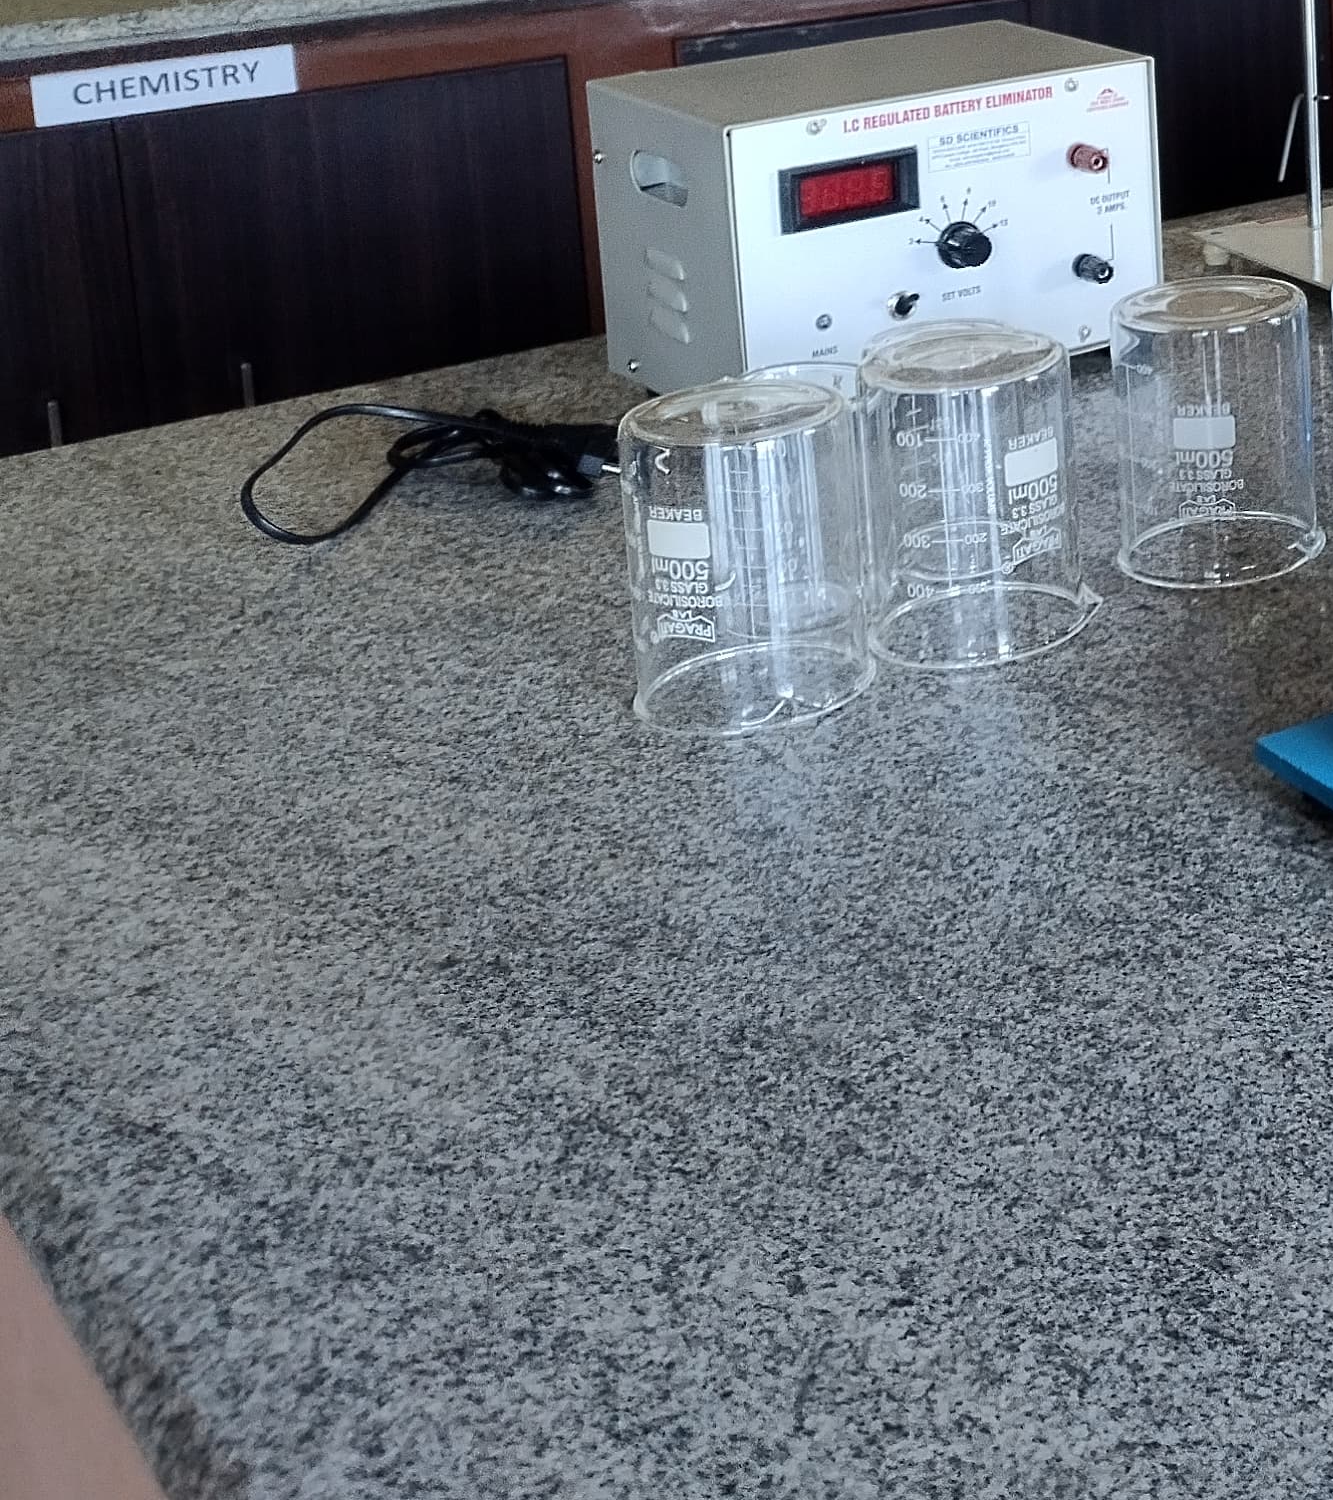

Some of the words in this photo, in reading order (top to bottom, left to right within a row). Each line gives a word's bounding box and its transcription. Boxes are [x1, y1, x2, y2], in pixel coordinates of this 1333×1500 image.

[72, 60, 261, 106] CHEMISTRY
[843, 118, 860, 133] I.C
[863, 107, 931, 131] REGULATED
[934, 97, 983, 119] BATTERY
[986, 86, 1054, 110] ELIMINATOR
[939, 135, 954, 147] SD
[956, 124, 1019, 145] SCIENTIFICS
[1101, 190, 1130, 204] OUTPUT
[941, 292, 956, 303] SET
[957, 285, 982, 299] VOLTS
[811, 345, 839, 358] MAINS
[1176, 401, 1231, 417] BEAKER
[895, 430, 924, 448] 100
[1007, 426, 1054, 450] BEAKER
[1175, 450, 1234, 469] 500ml
[1196, 468, 1232, 481] GLASS
[899, 482, 928, 499] 200
[1007, 474, 1058, 505] 500ml
[1169, 478, 1245, 493] BOROSILICATE
[1028, 493, 1058, 514] GLASS
[648, 505, 703, 521] BEAKER
[1000, 501, 1066, 536] BOROSILICATE
[903, 533, 932, 549] 300
[963, 531, 988, 545] 200
[1015, 531, 1061, 561] PRAGATI
[651, 557, 710, 581] 500ml
[670, 581, 709, 595] GLASS
[907, 583, 935, 598] 400
[647, 589, 724, 608] BOROSILICATE
[660, 620, 713, 638] PRAGATI
